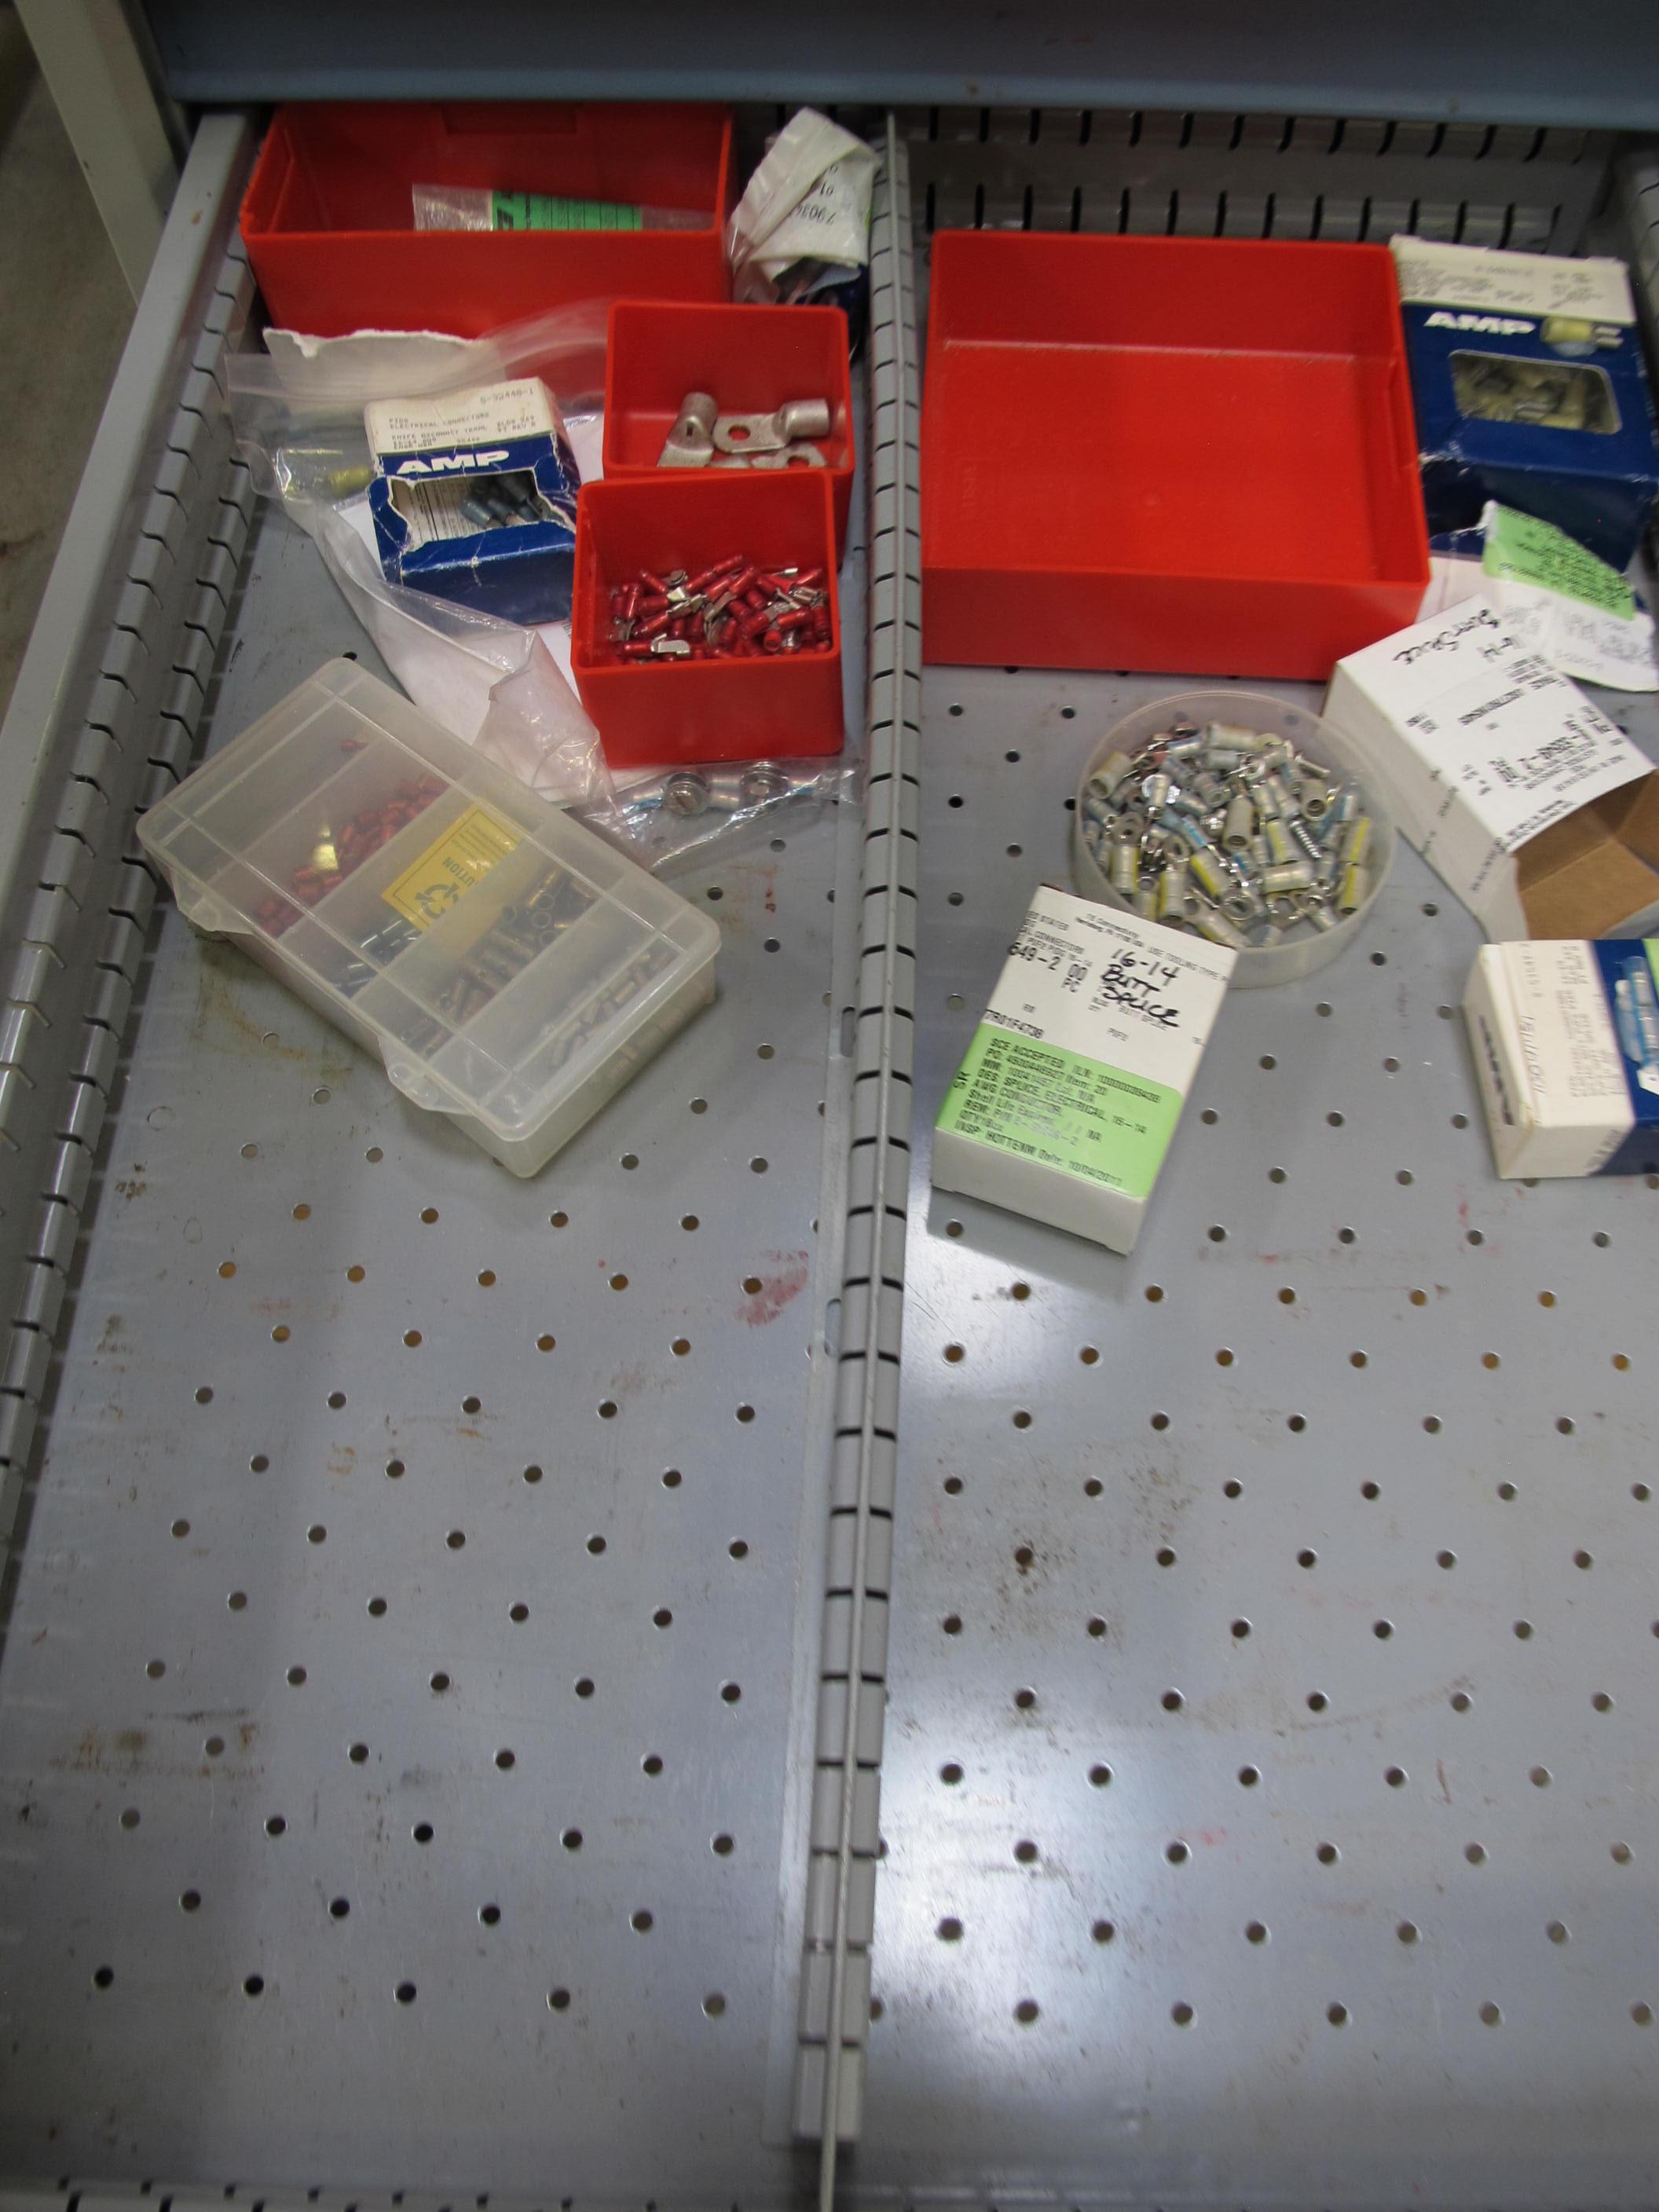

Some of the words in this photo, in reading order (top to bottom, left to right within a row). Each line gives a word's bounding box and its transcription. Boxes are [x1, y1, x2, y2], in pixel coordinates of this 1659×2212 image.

[1423, 312, 1536, 335] AMP
[390, 421, 437, 430] ELECTRICAL
[442, 412, 489, 426] CONNECTORS
[397, 450, 509, 475] AMP
[441, 856, 478, 887] UTION
[1035, 931, 1085, 955] CONNECTORS
[1099, 964, 1161, 998] BUTT
[1108, 948, 1181, 987] 16-14
[1101, 986, 1181, 1028] SPLICE
[989, 1036, 1012, 1052] SCE
[1012, 1044, 1065, 1070] ACCEPTED
